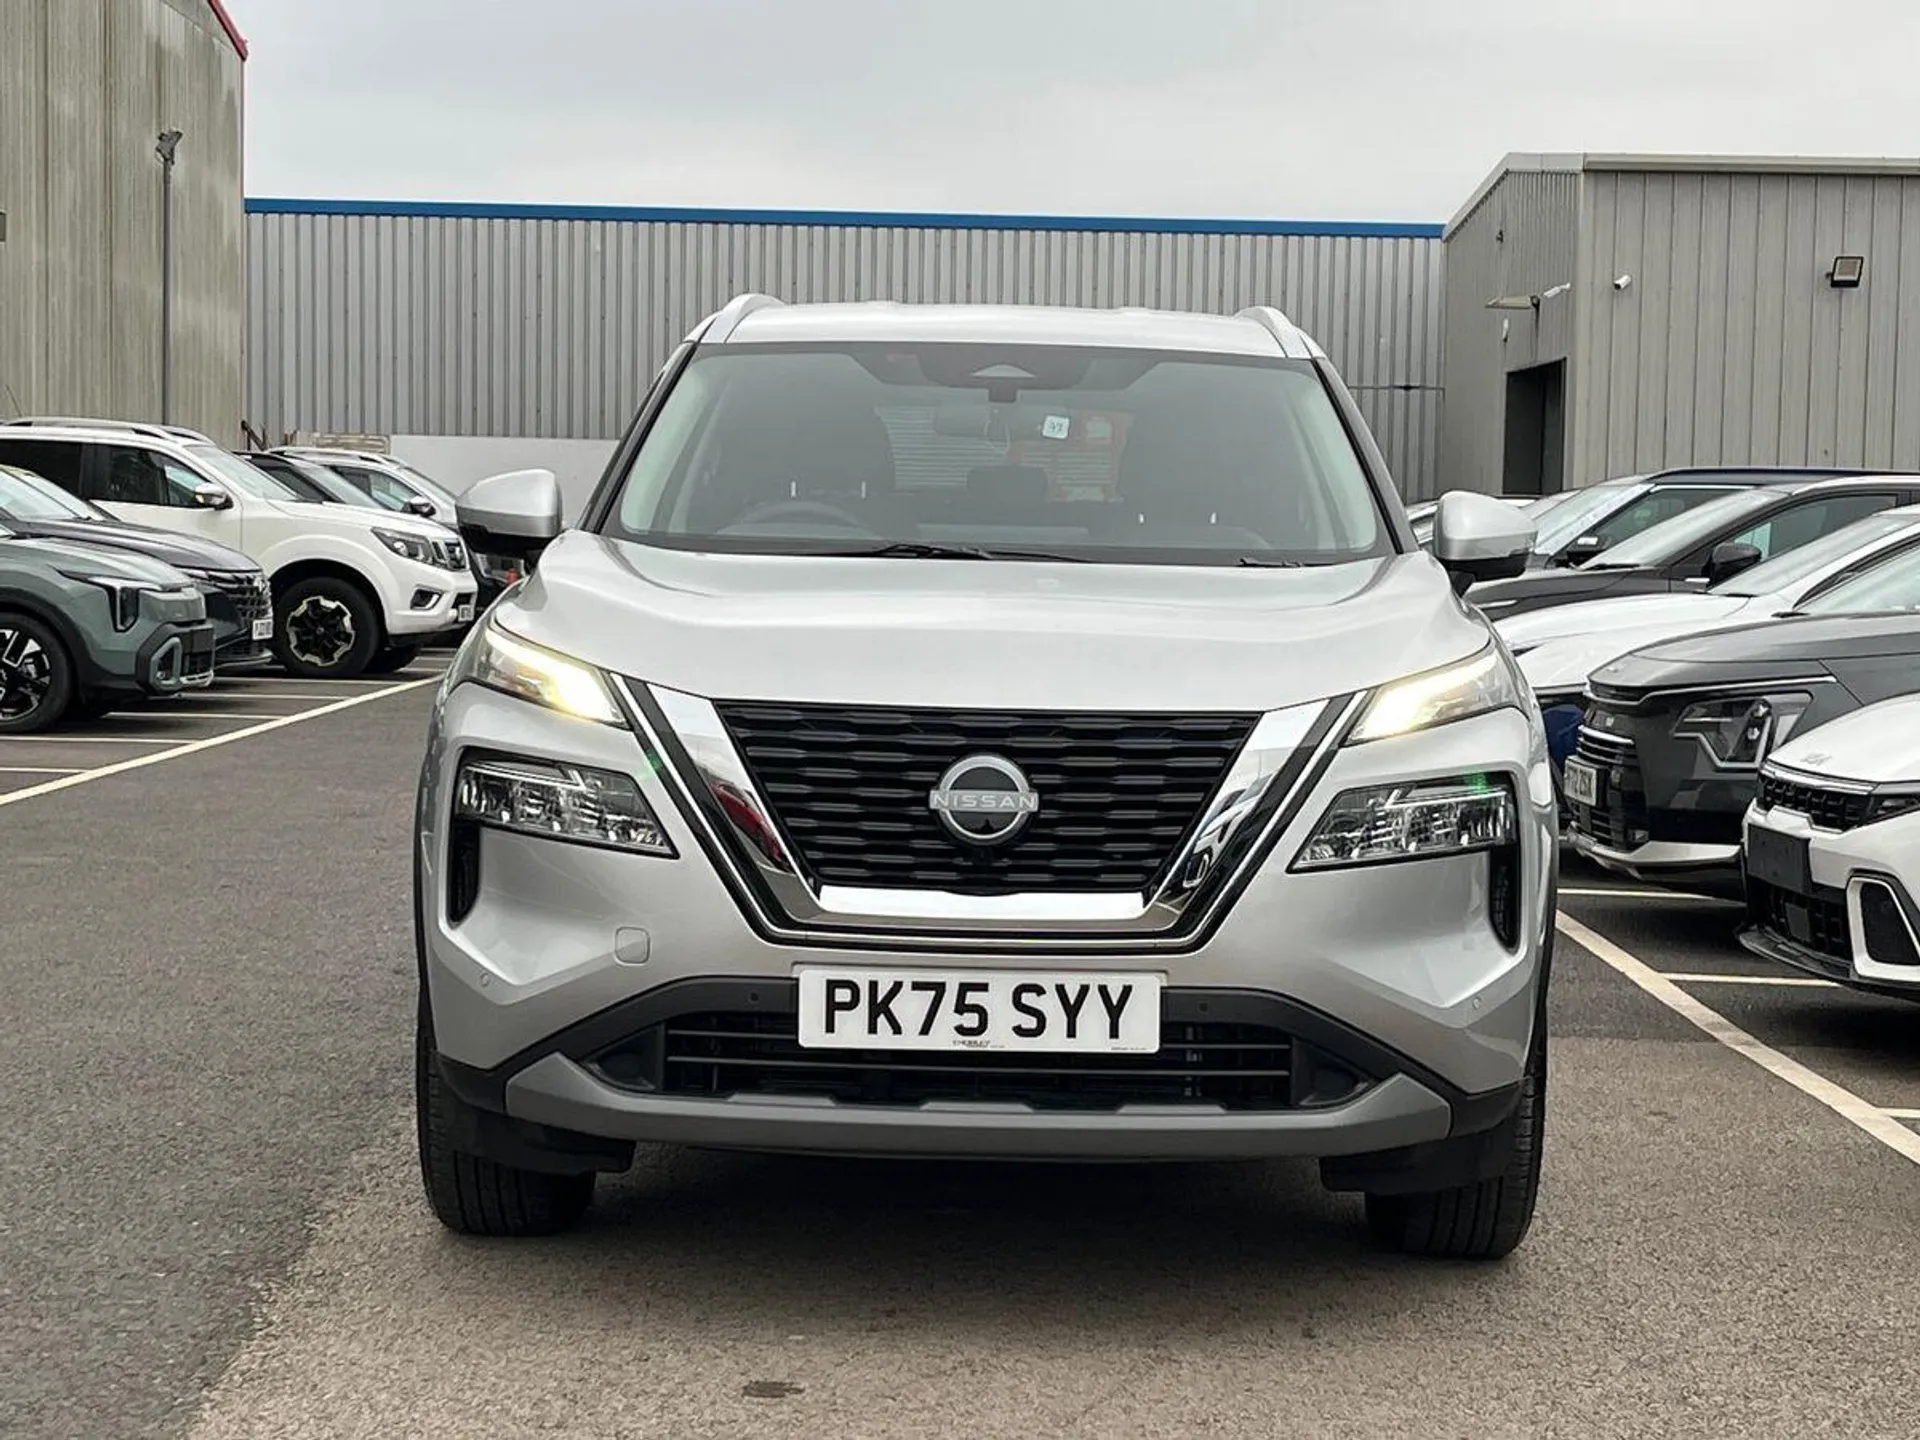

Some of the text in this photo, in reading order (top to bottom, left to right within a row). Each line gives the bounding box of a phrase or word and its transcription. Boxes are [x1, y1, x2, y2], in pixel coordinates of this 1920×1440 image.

[934, 794, 1035, 809] NISSAN
[824, 979, 1134, 1040] PK75 SYY
